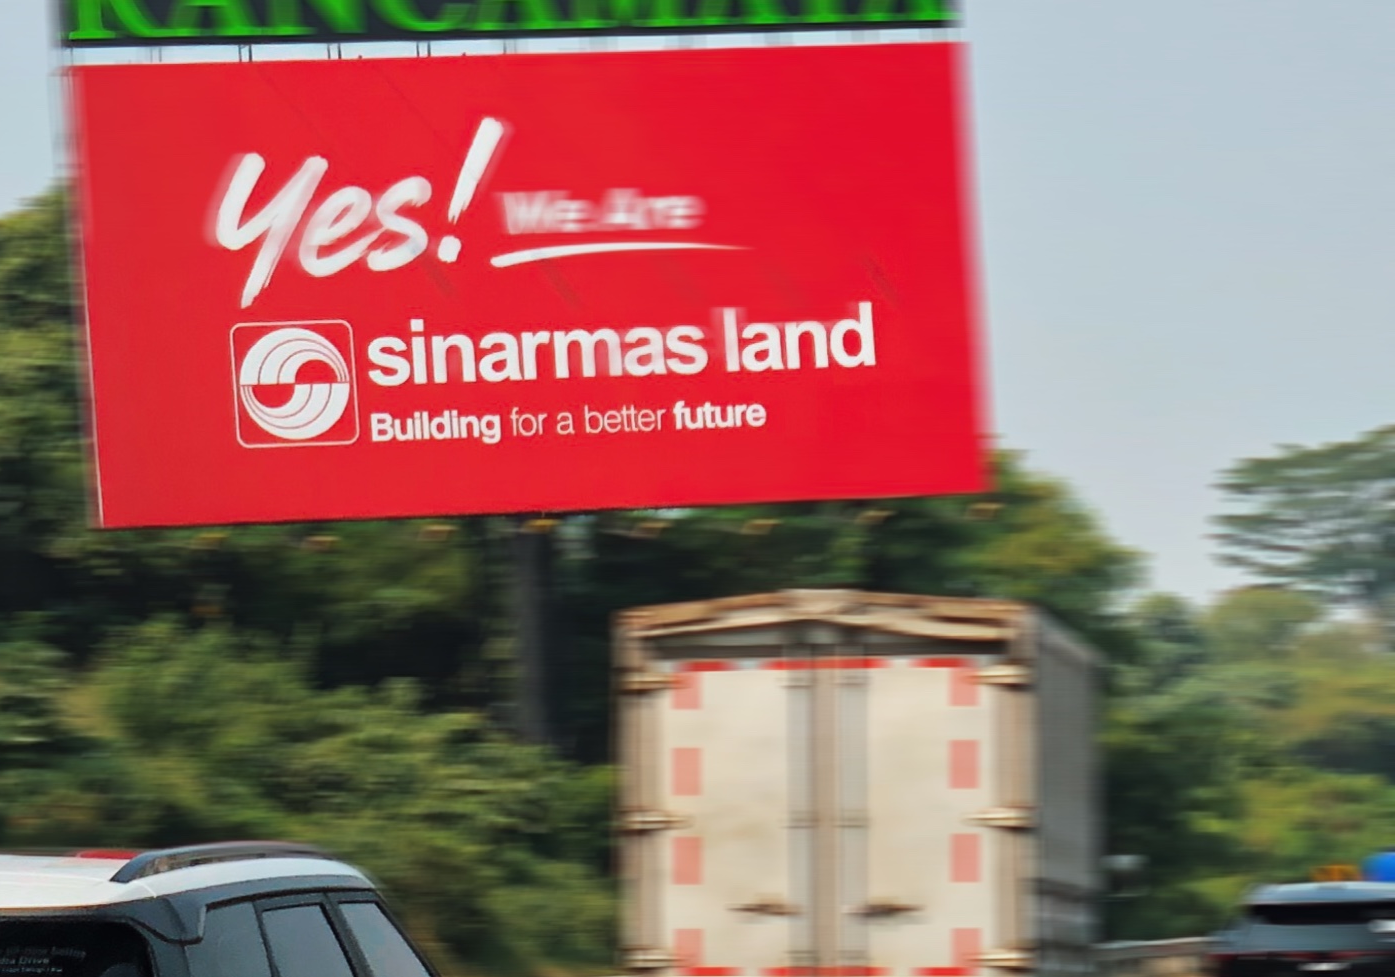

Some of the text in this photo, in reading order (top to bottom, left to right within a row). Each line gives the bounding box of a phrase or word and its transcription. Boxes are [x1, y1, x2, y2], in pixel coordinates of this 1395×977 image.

[214, 117, 507, 309] Yes!
[367, 300, 876, 387] sinarmas land
[370, 400, 767, 444] Building for a better future
